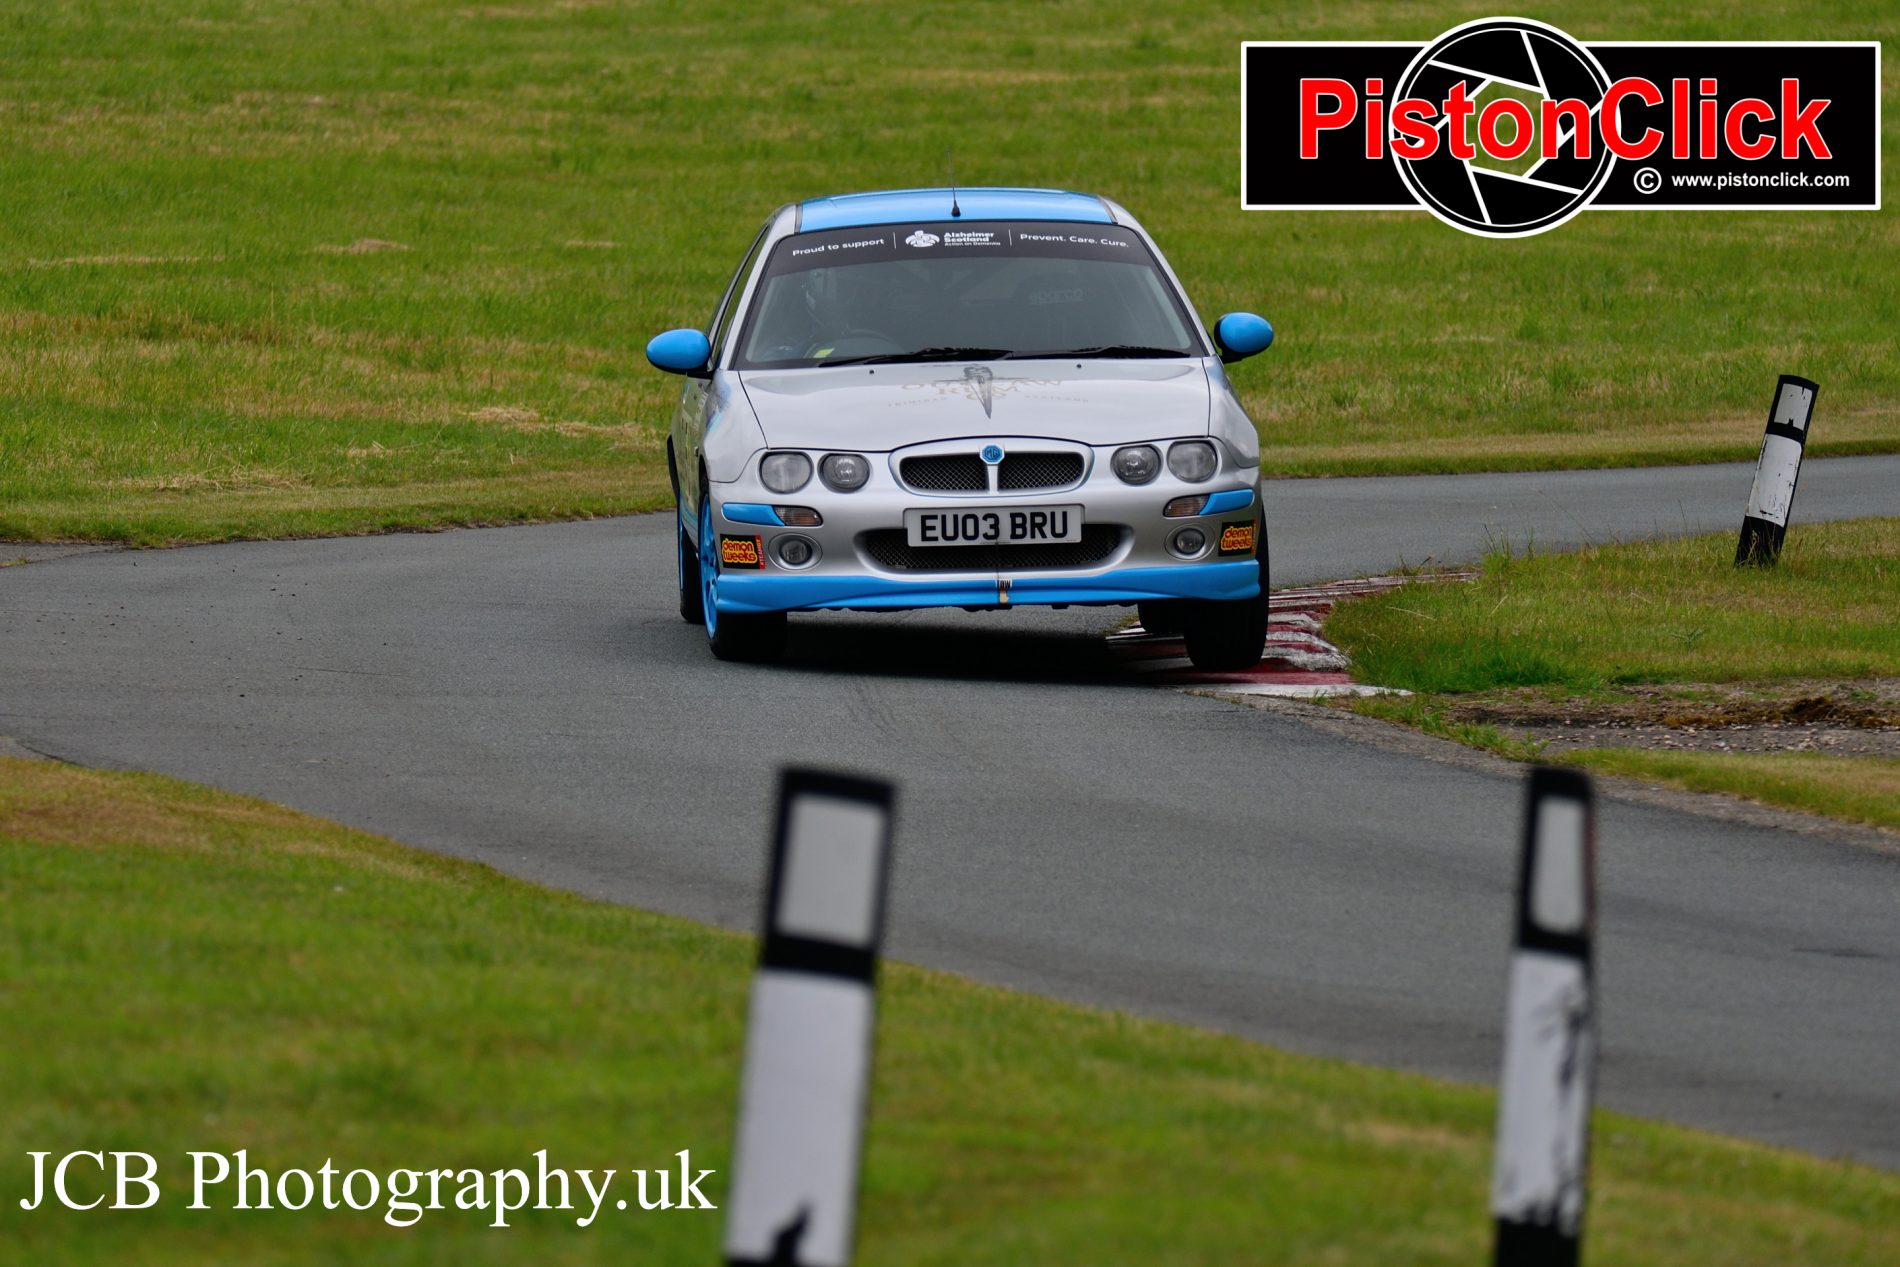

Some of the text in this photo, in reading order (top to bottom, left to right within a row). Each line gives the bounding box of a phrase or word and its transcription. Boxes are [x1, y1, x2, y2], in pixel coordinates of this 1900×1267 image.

[792, 245, 825, 257] Proud
[842, 238, 885, 249] support
[1019, 233, 1129, 248] Prevent. Care. Cure.
[920, 511, 1068, 542] EU03 BRU
[722, 538, 754, 552] demon
[722, 550, 757, 563] tweeks
